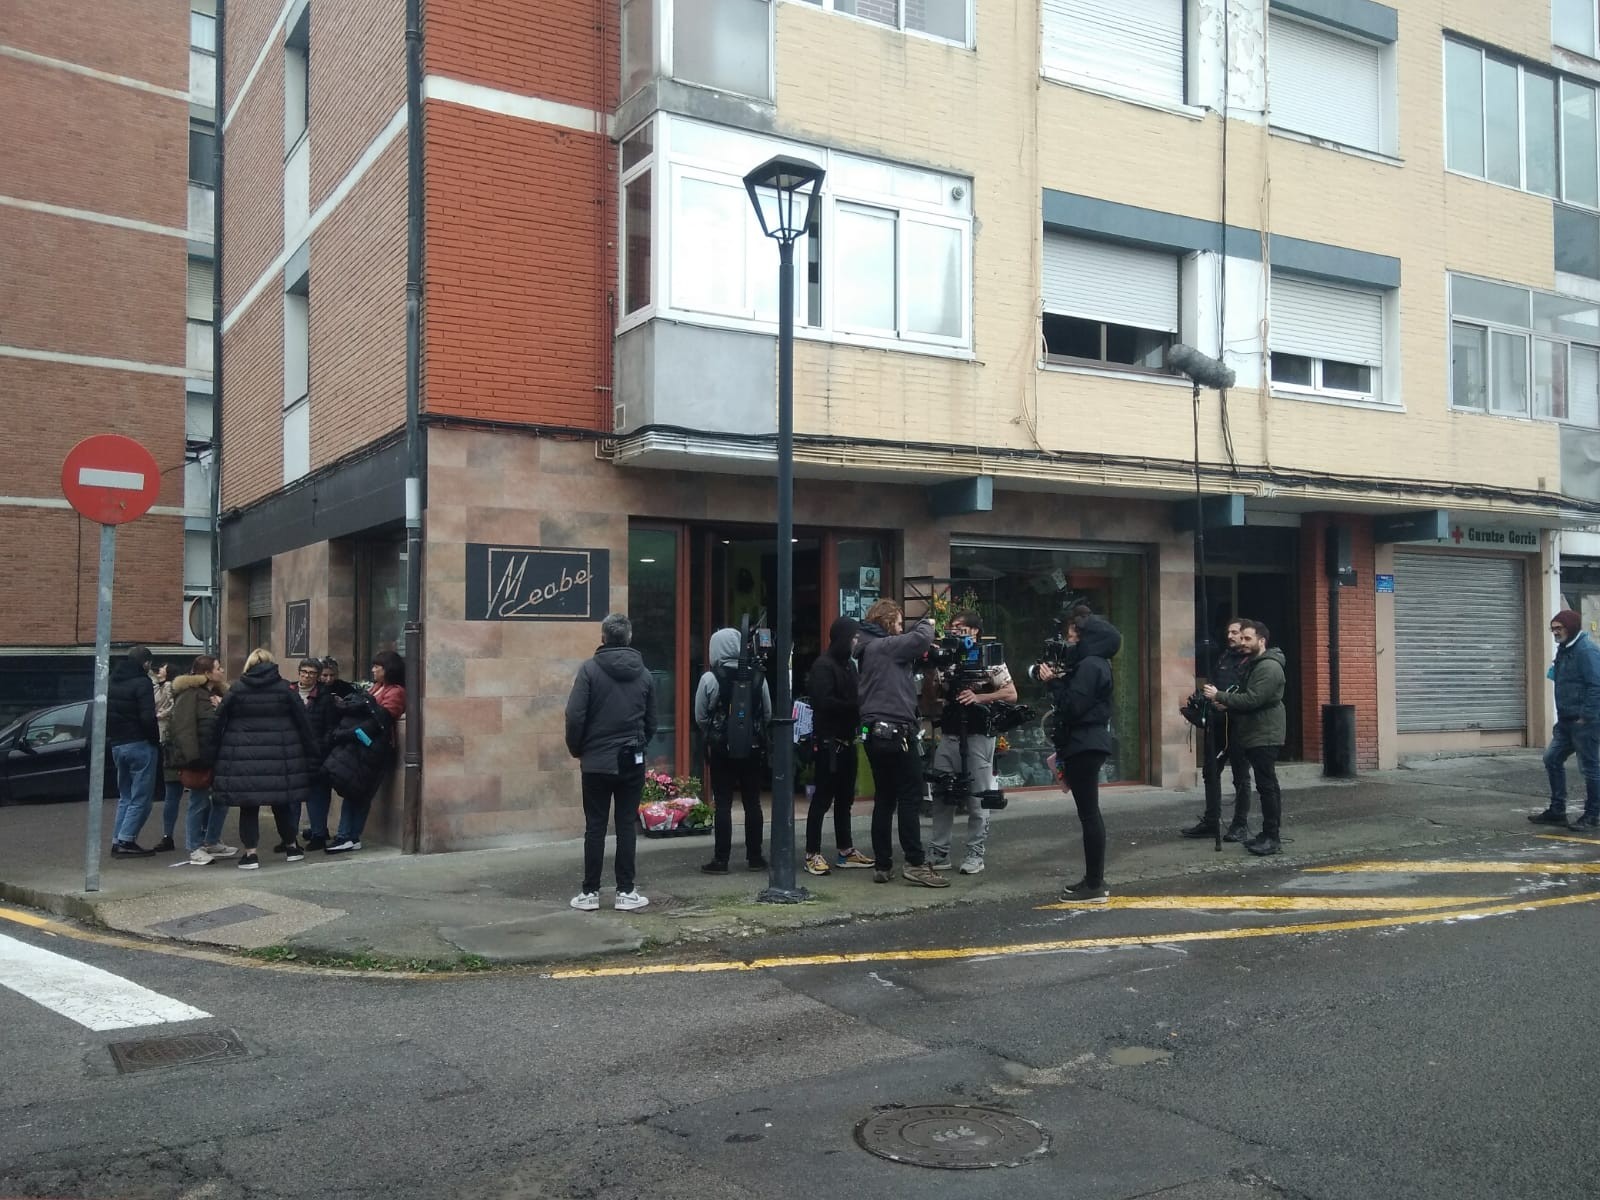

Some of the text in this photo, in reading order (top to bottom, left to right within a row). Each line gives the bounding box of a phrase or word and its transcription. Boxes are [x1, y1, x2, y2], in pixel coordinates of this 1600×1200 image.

[1468, 527, 1537, 545] Gurutze Gorria
[485, 554, 593, 619] Meabe
